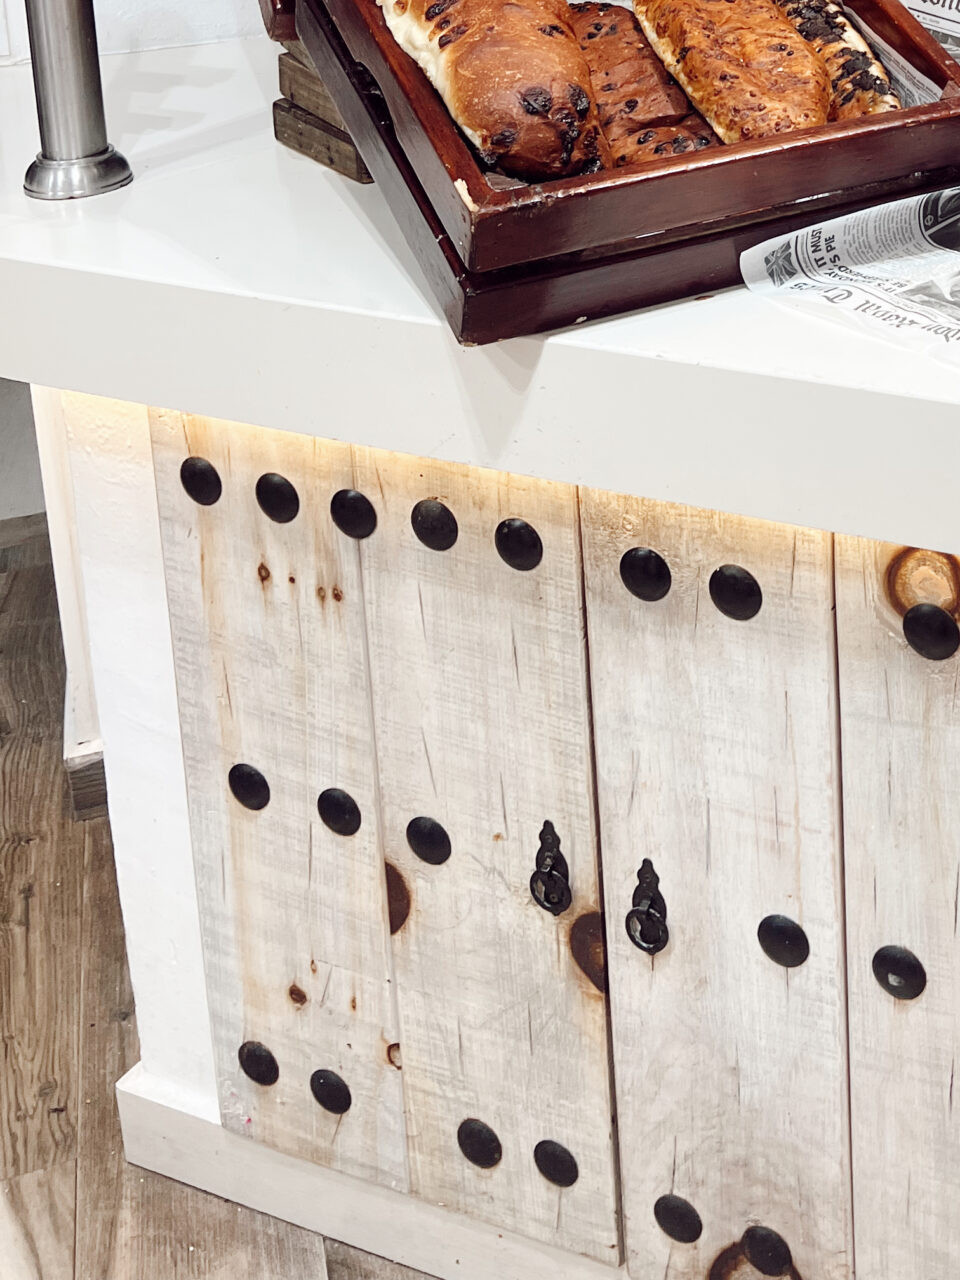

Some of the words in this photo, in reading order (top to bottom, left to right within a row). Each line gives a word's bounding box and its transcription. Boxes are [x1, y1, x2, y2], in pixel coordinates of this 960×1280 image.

[810, 227, 823, 254] MUST
[824, 234, 836, 253] PIE
[814, 255, 827, 268] IT
